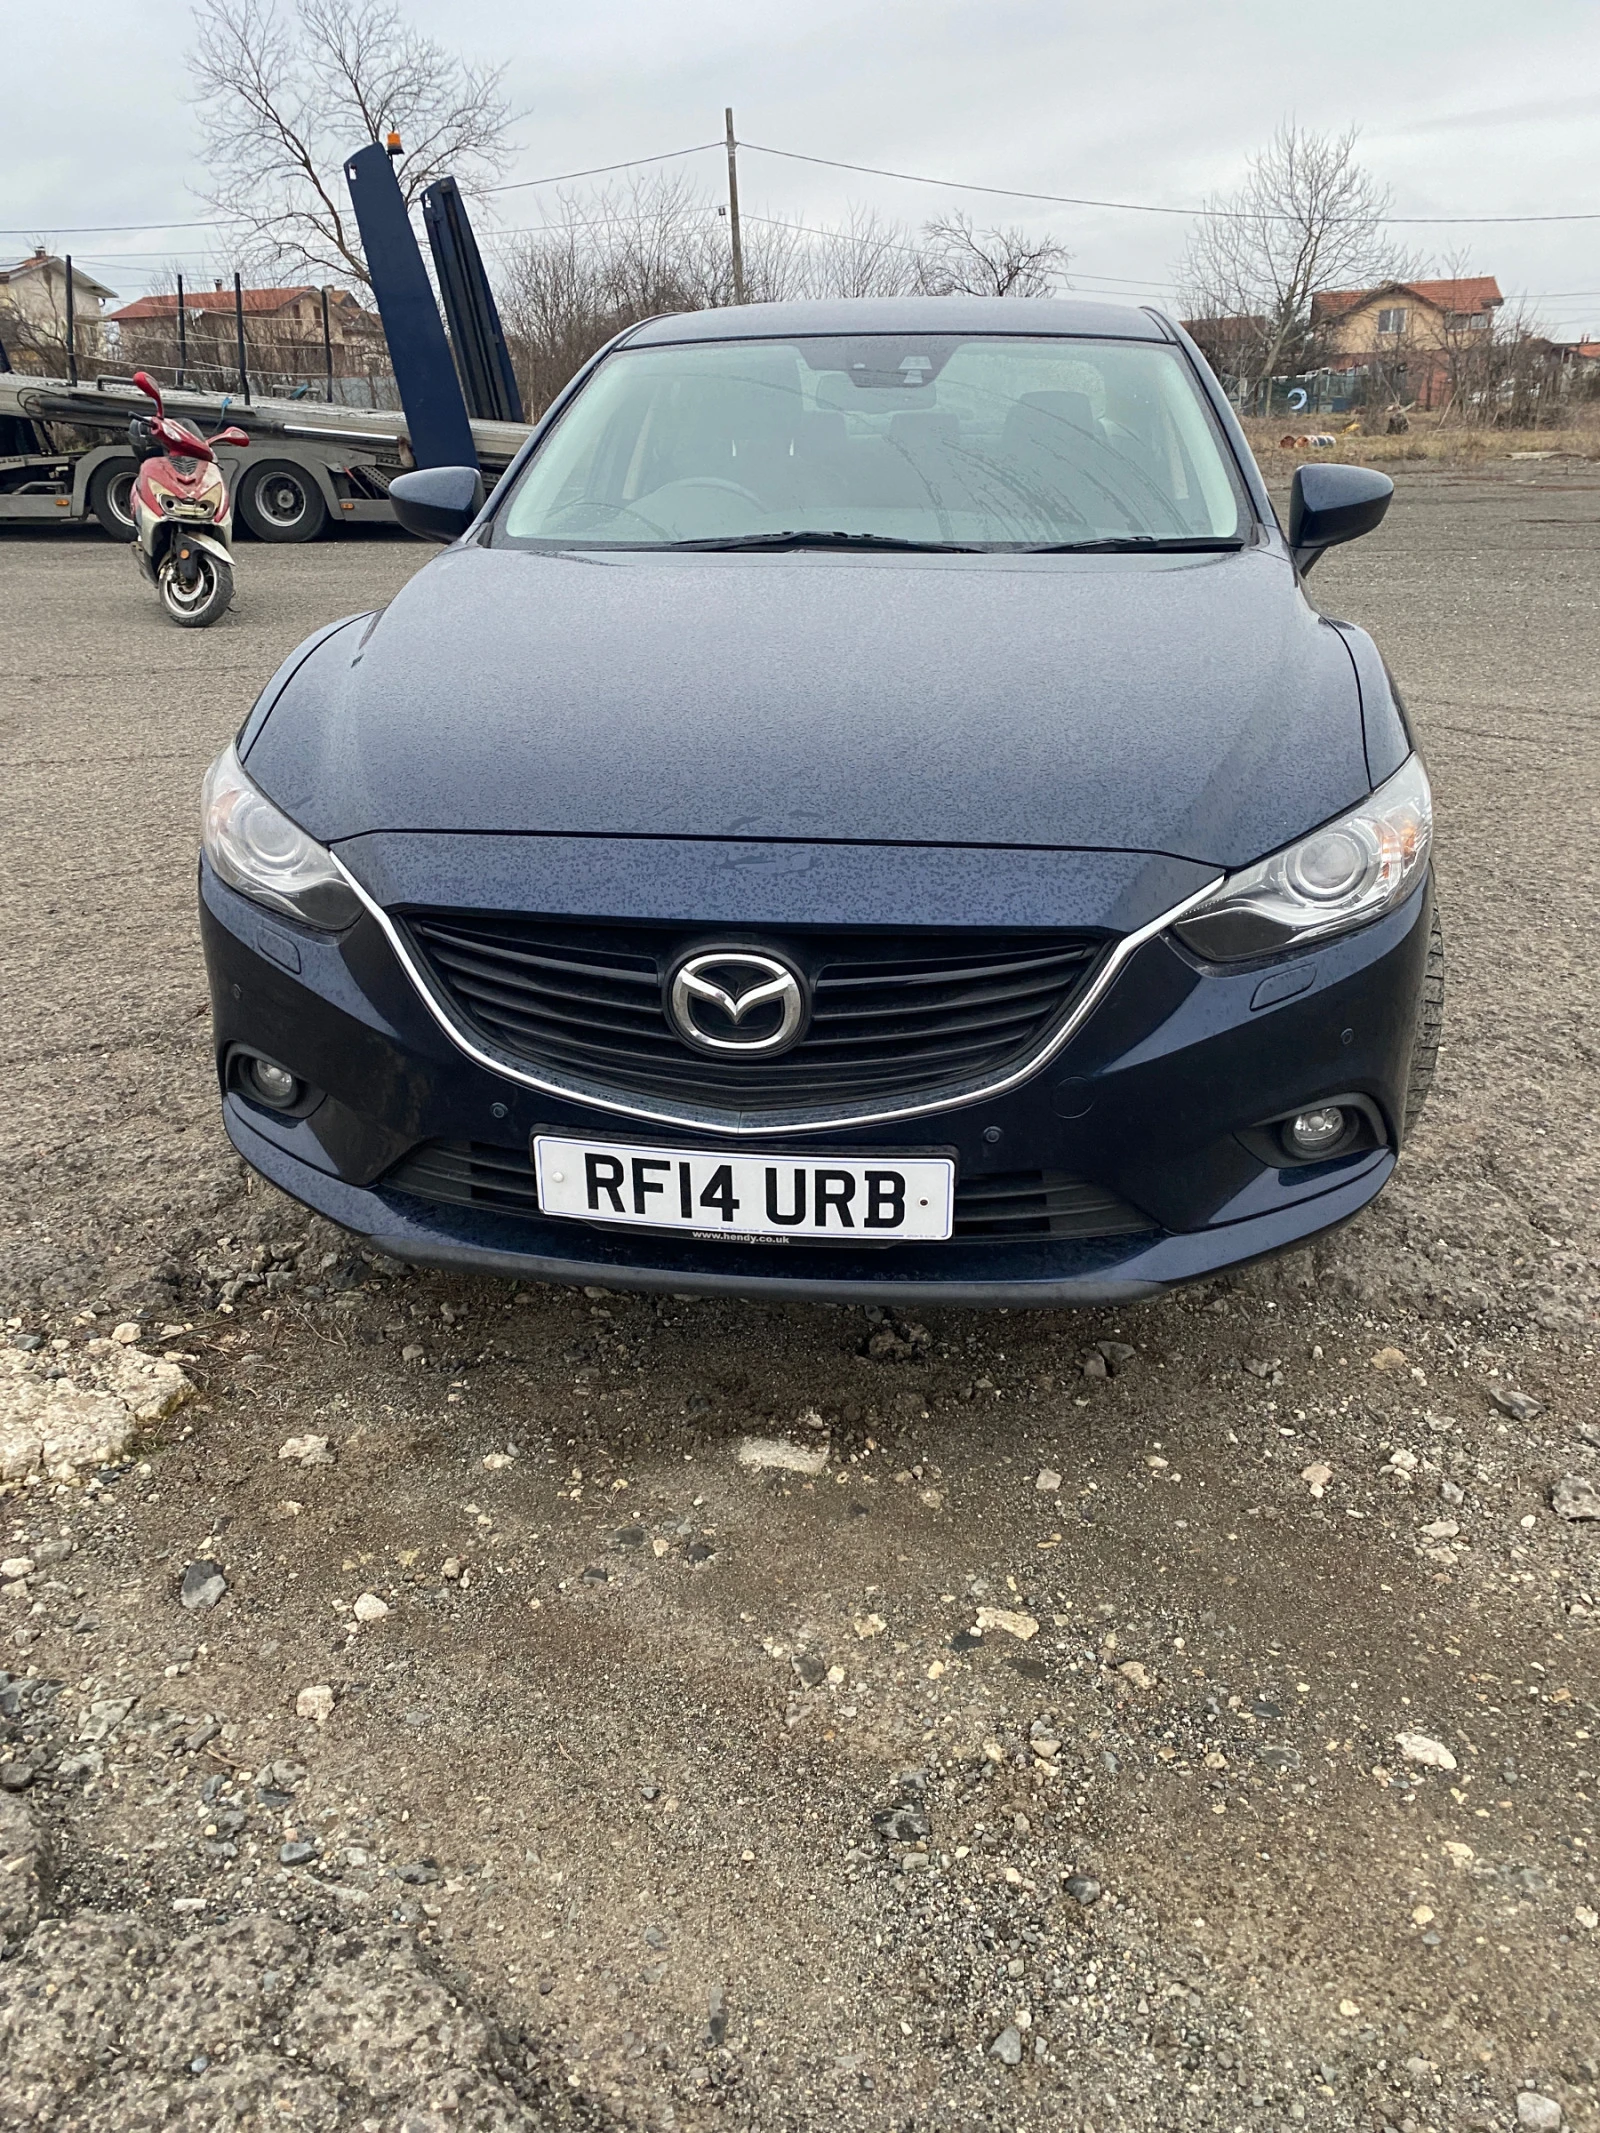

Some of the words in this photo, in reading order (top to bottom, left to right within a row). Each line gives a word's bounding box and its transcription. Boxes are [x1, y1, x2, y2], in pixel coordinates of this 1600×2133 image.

[584, 1152, 740, 1223] RF14
[765, 1167, 906, 1229] URB
[692, 1230, 790, 1245] www.hendy.co.uk
